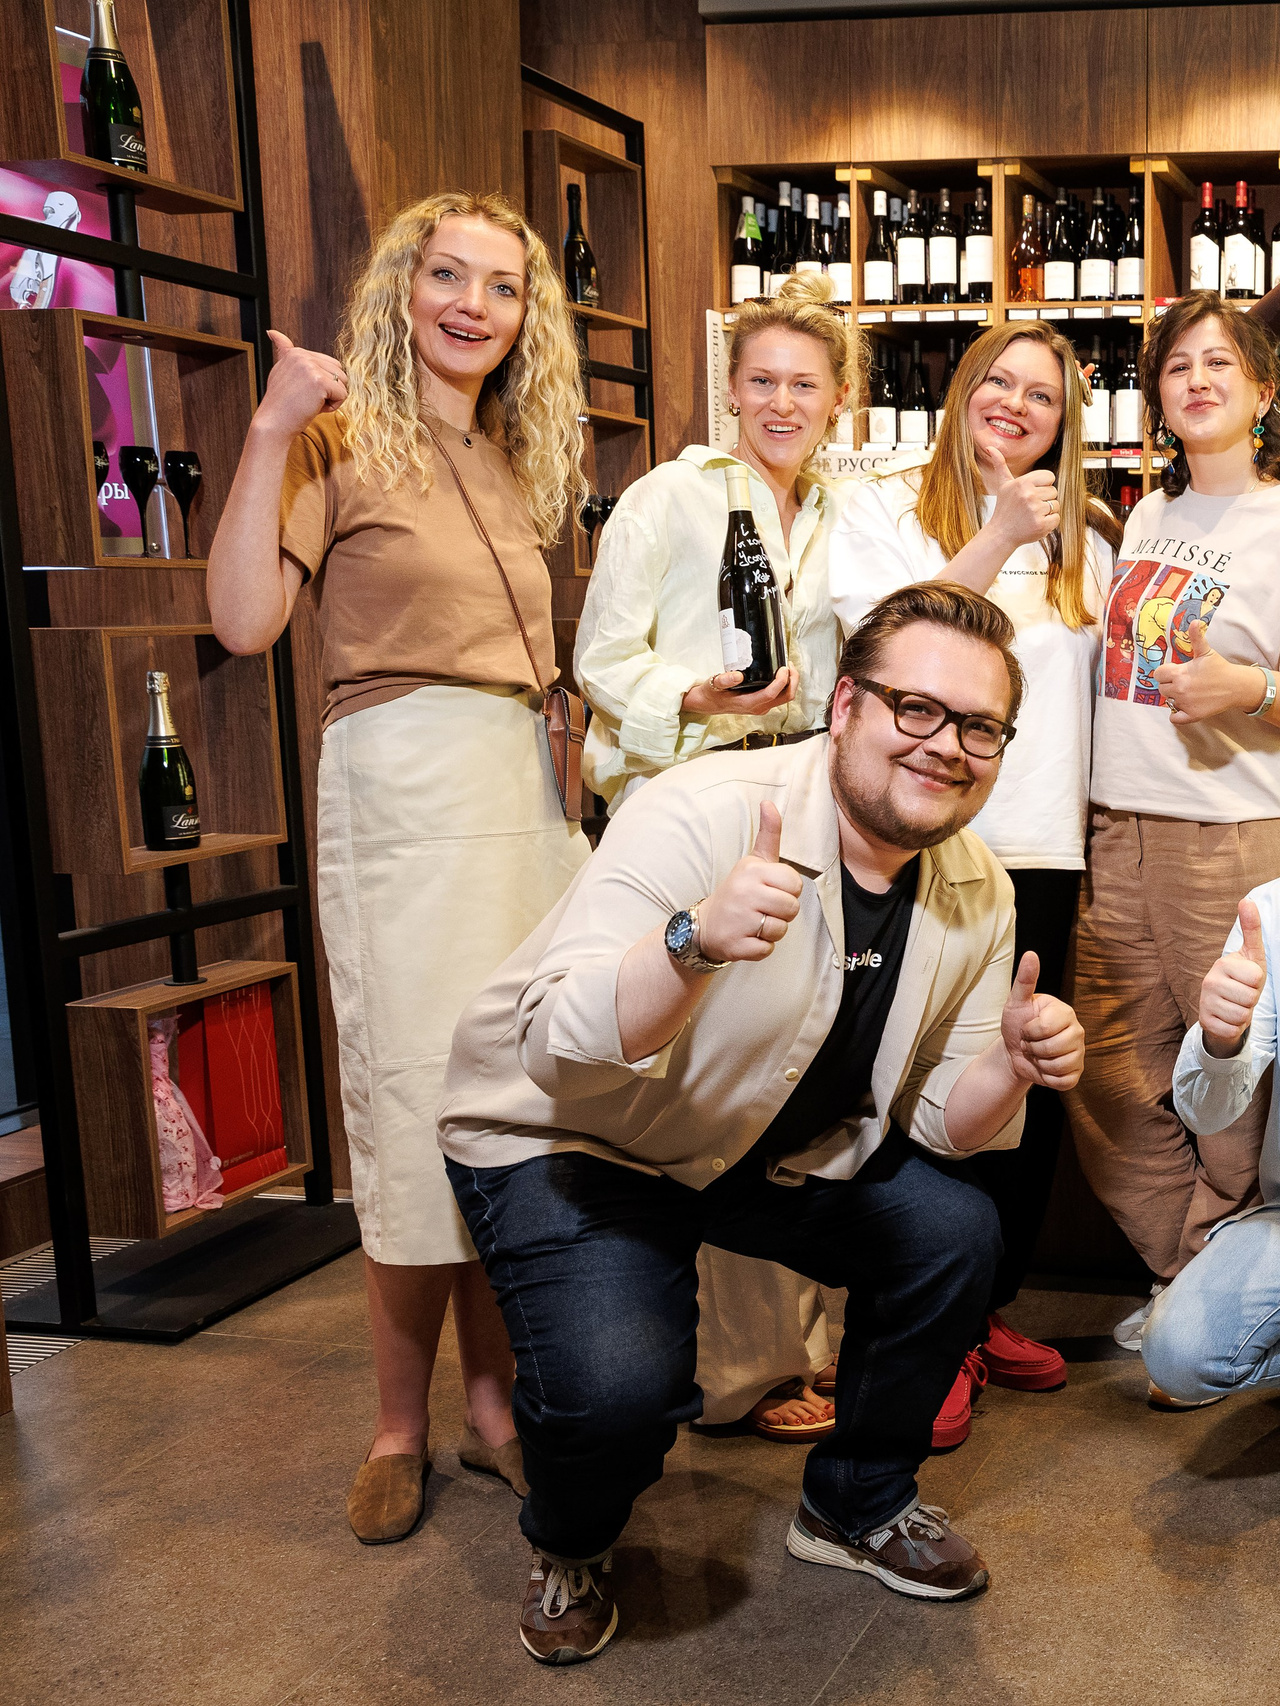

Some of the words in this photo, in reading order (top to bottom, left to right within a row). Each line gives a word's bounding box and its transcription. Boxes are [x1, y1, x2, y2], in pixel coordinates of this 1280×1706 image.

[837, 457, 896, 472] РУСС
[98, 482, 130, 506] ры
[1131, 538, 1232, 573] MATISSÉ
